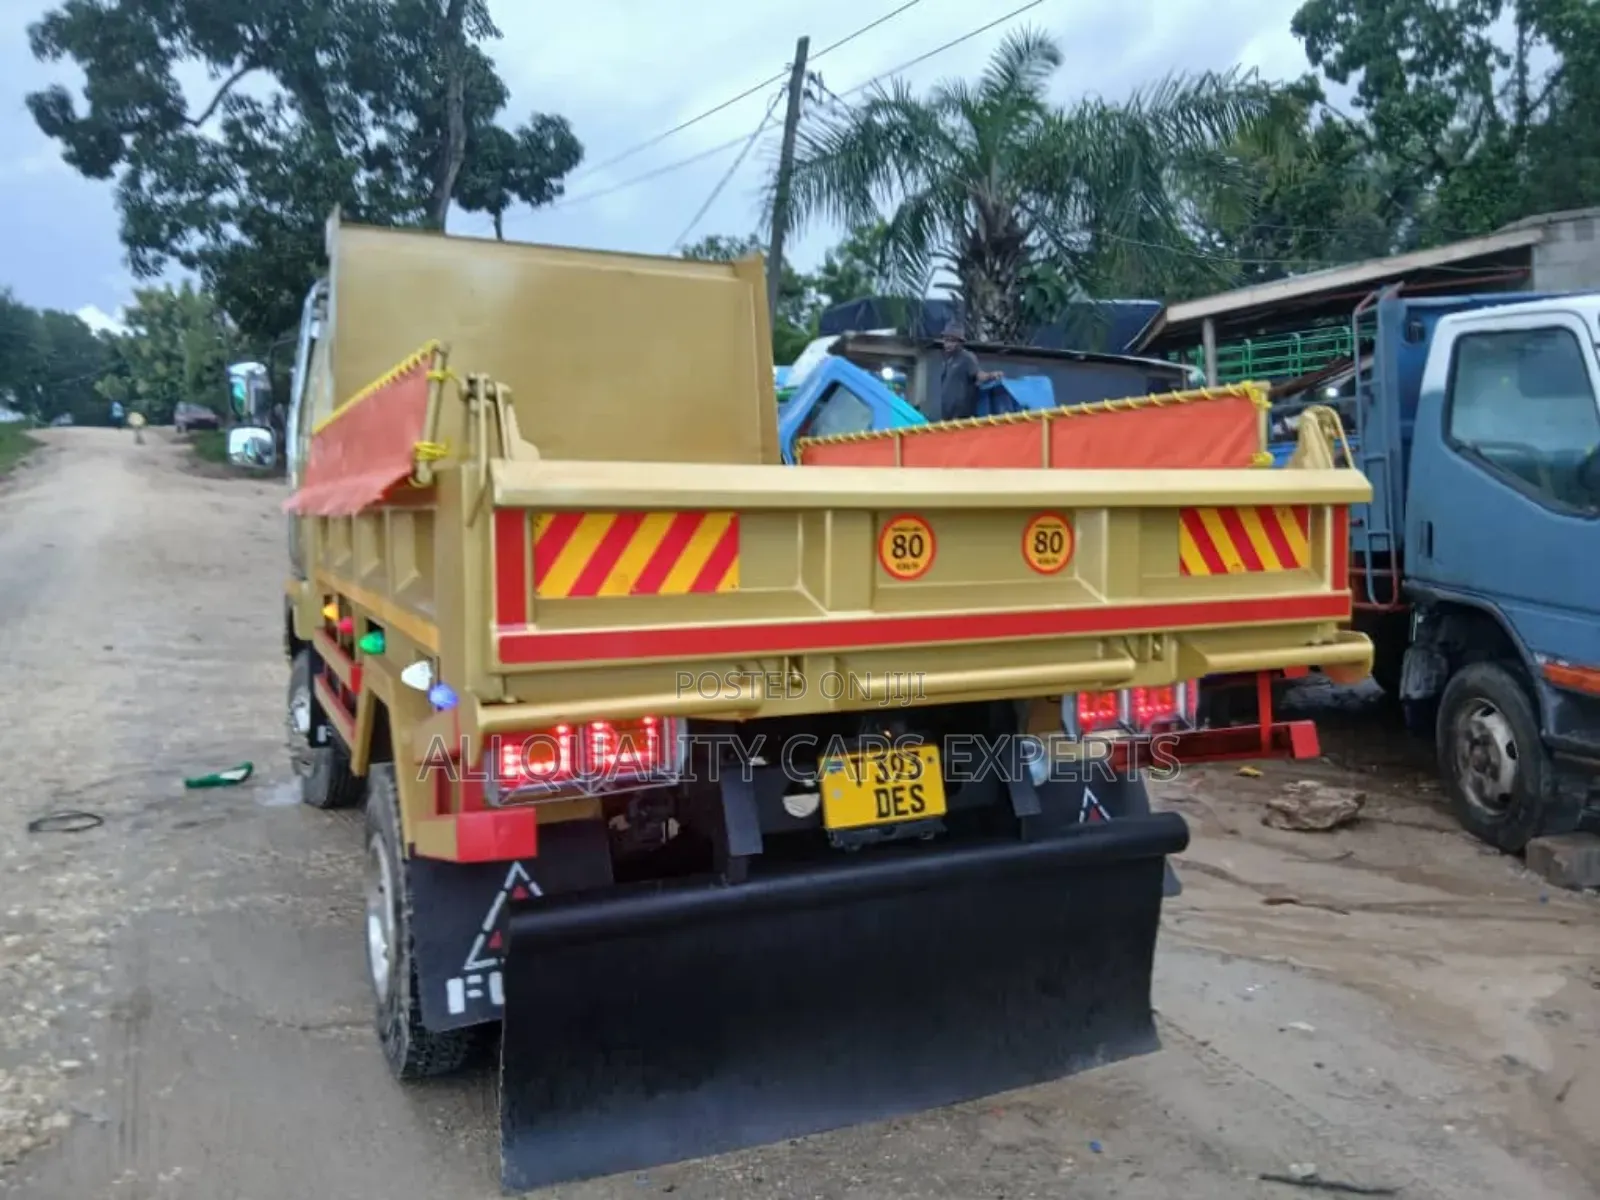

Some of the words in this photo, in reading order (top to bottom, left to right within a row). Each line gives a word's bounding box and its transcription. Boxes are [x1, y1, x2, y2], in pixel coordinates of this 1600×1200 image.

[891, 533, 924, 559] 80
[1034, 530, 1064, 554] 80
[850, 756, 864, 788] T
[874, 784, 925, 818] DES
